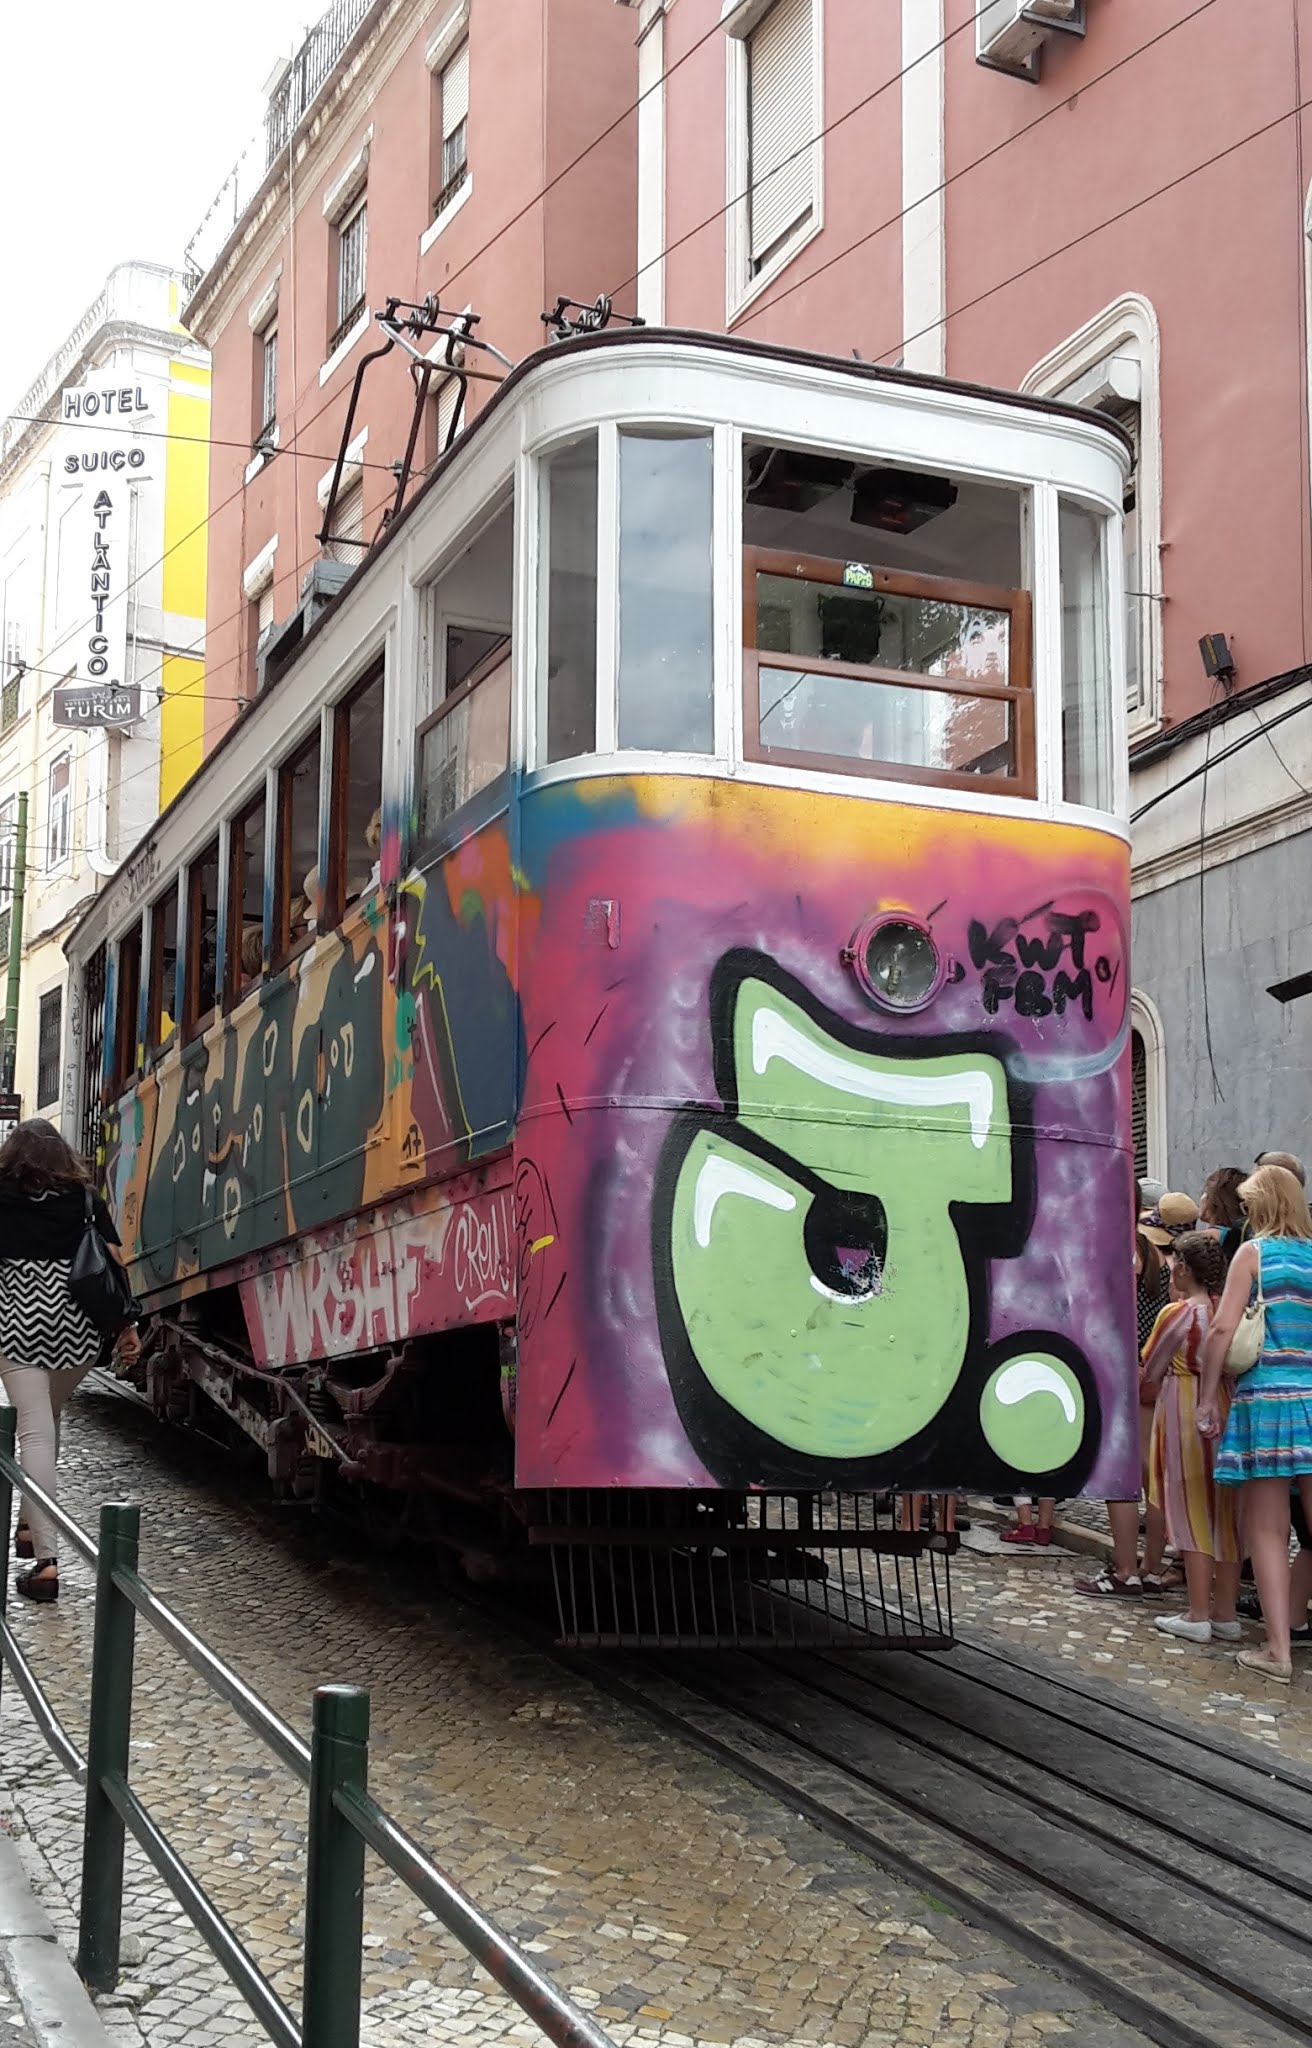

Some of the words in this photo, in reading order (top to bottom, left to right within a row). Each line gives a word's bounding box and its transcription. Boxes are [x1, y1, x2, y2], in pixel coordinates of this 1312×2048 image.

[64, 387, 148, 418] HOTEL
[64, 448, 145, 472] SUIÇO
[64, 703, 131, 720] TURIM
